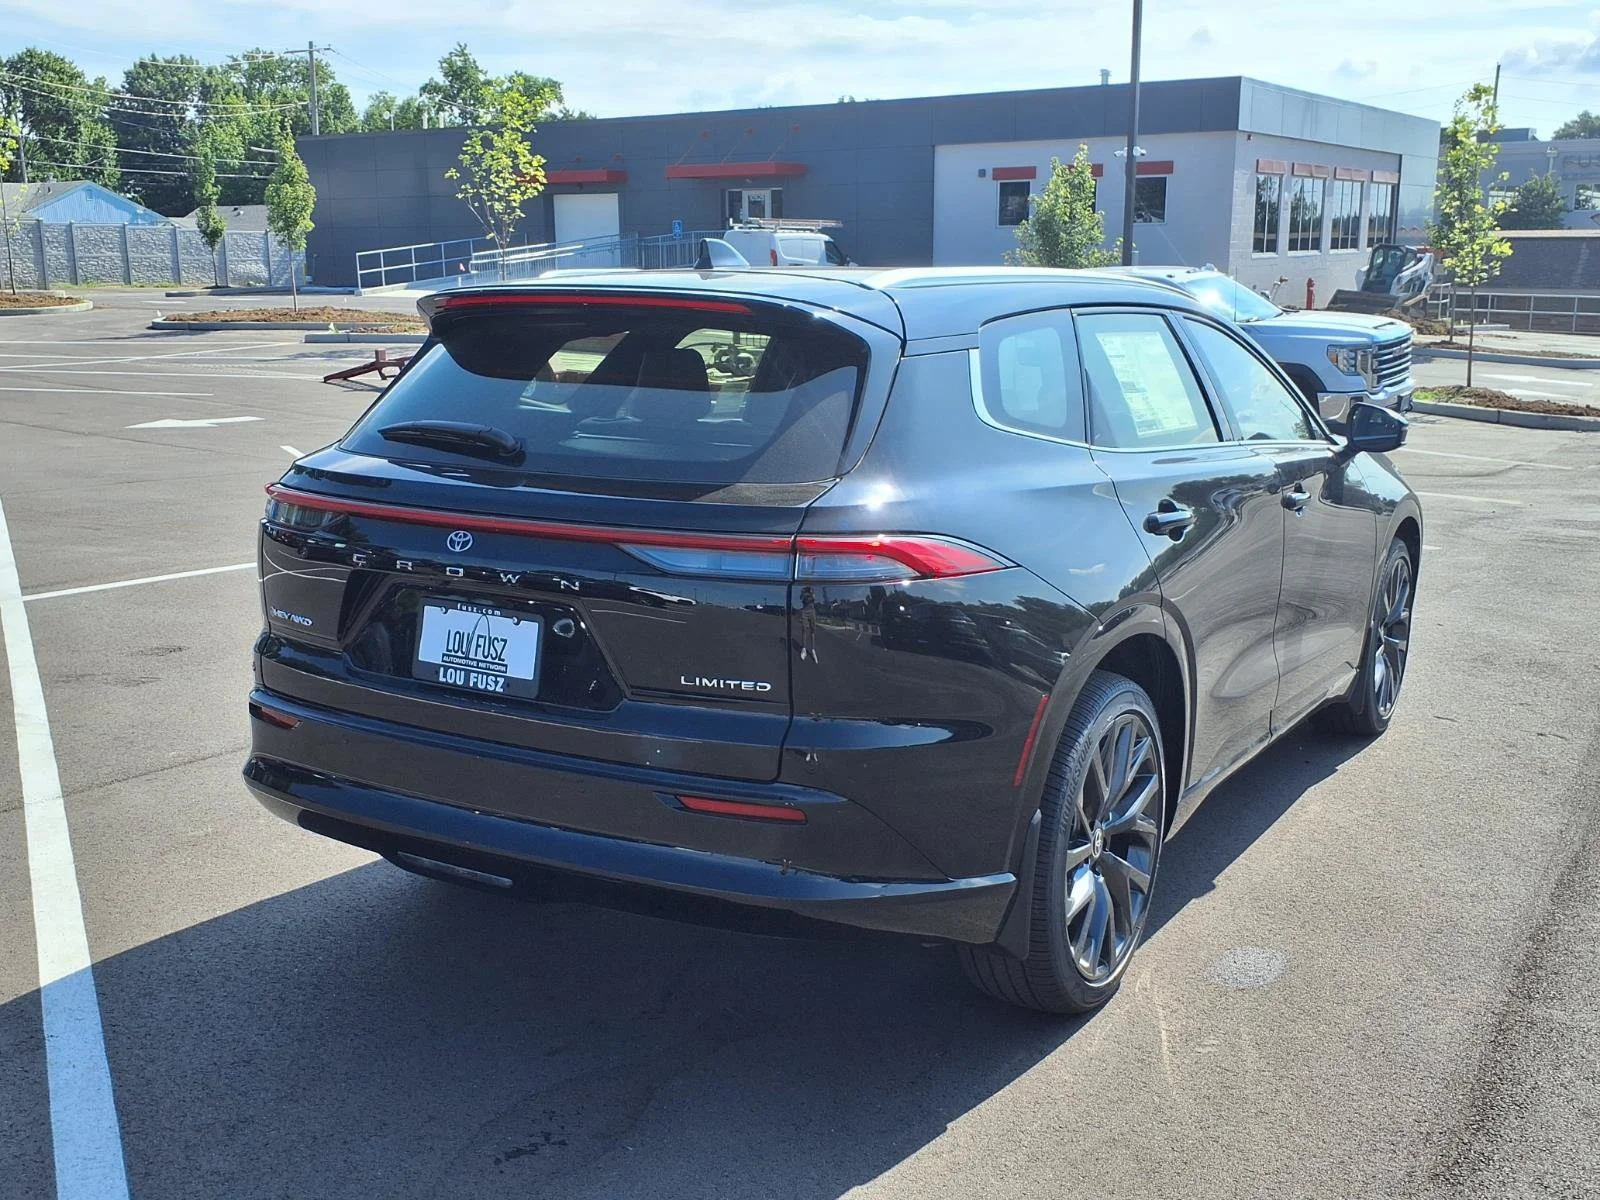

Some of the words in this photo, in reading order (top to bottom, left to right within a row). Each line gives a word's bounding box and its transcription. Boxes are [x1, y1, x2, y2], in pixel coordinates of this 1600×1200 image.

[352, 553, 580, 591] CROWN
[457, 602, 501, 616] fusz.com
[446, 629, 471, 657] LOU
[474, 633, 508, 662] FUSZ
[442, 655, 477, 667] AUTOMOTIVE
[478, 661, 507, 672] NETWORK
[439, 666, 465, 686] LOU
[469, 672, 505, 692] FUSZ
[680, 675, 772, 692] LIMITED
